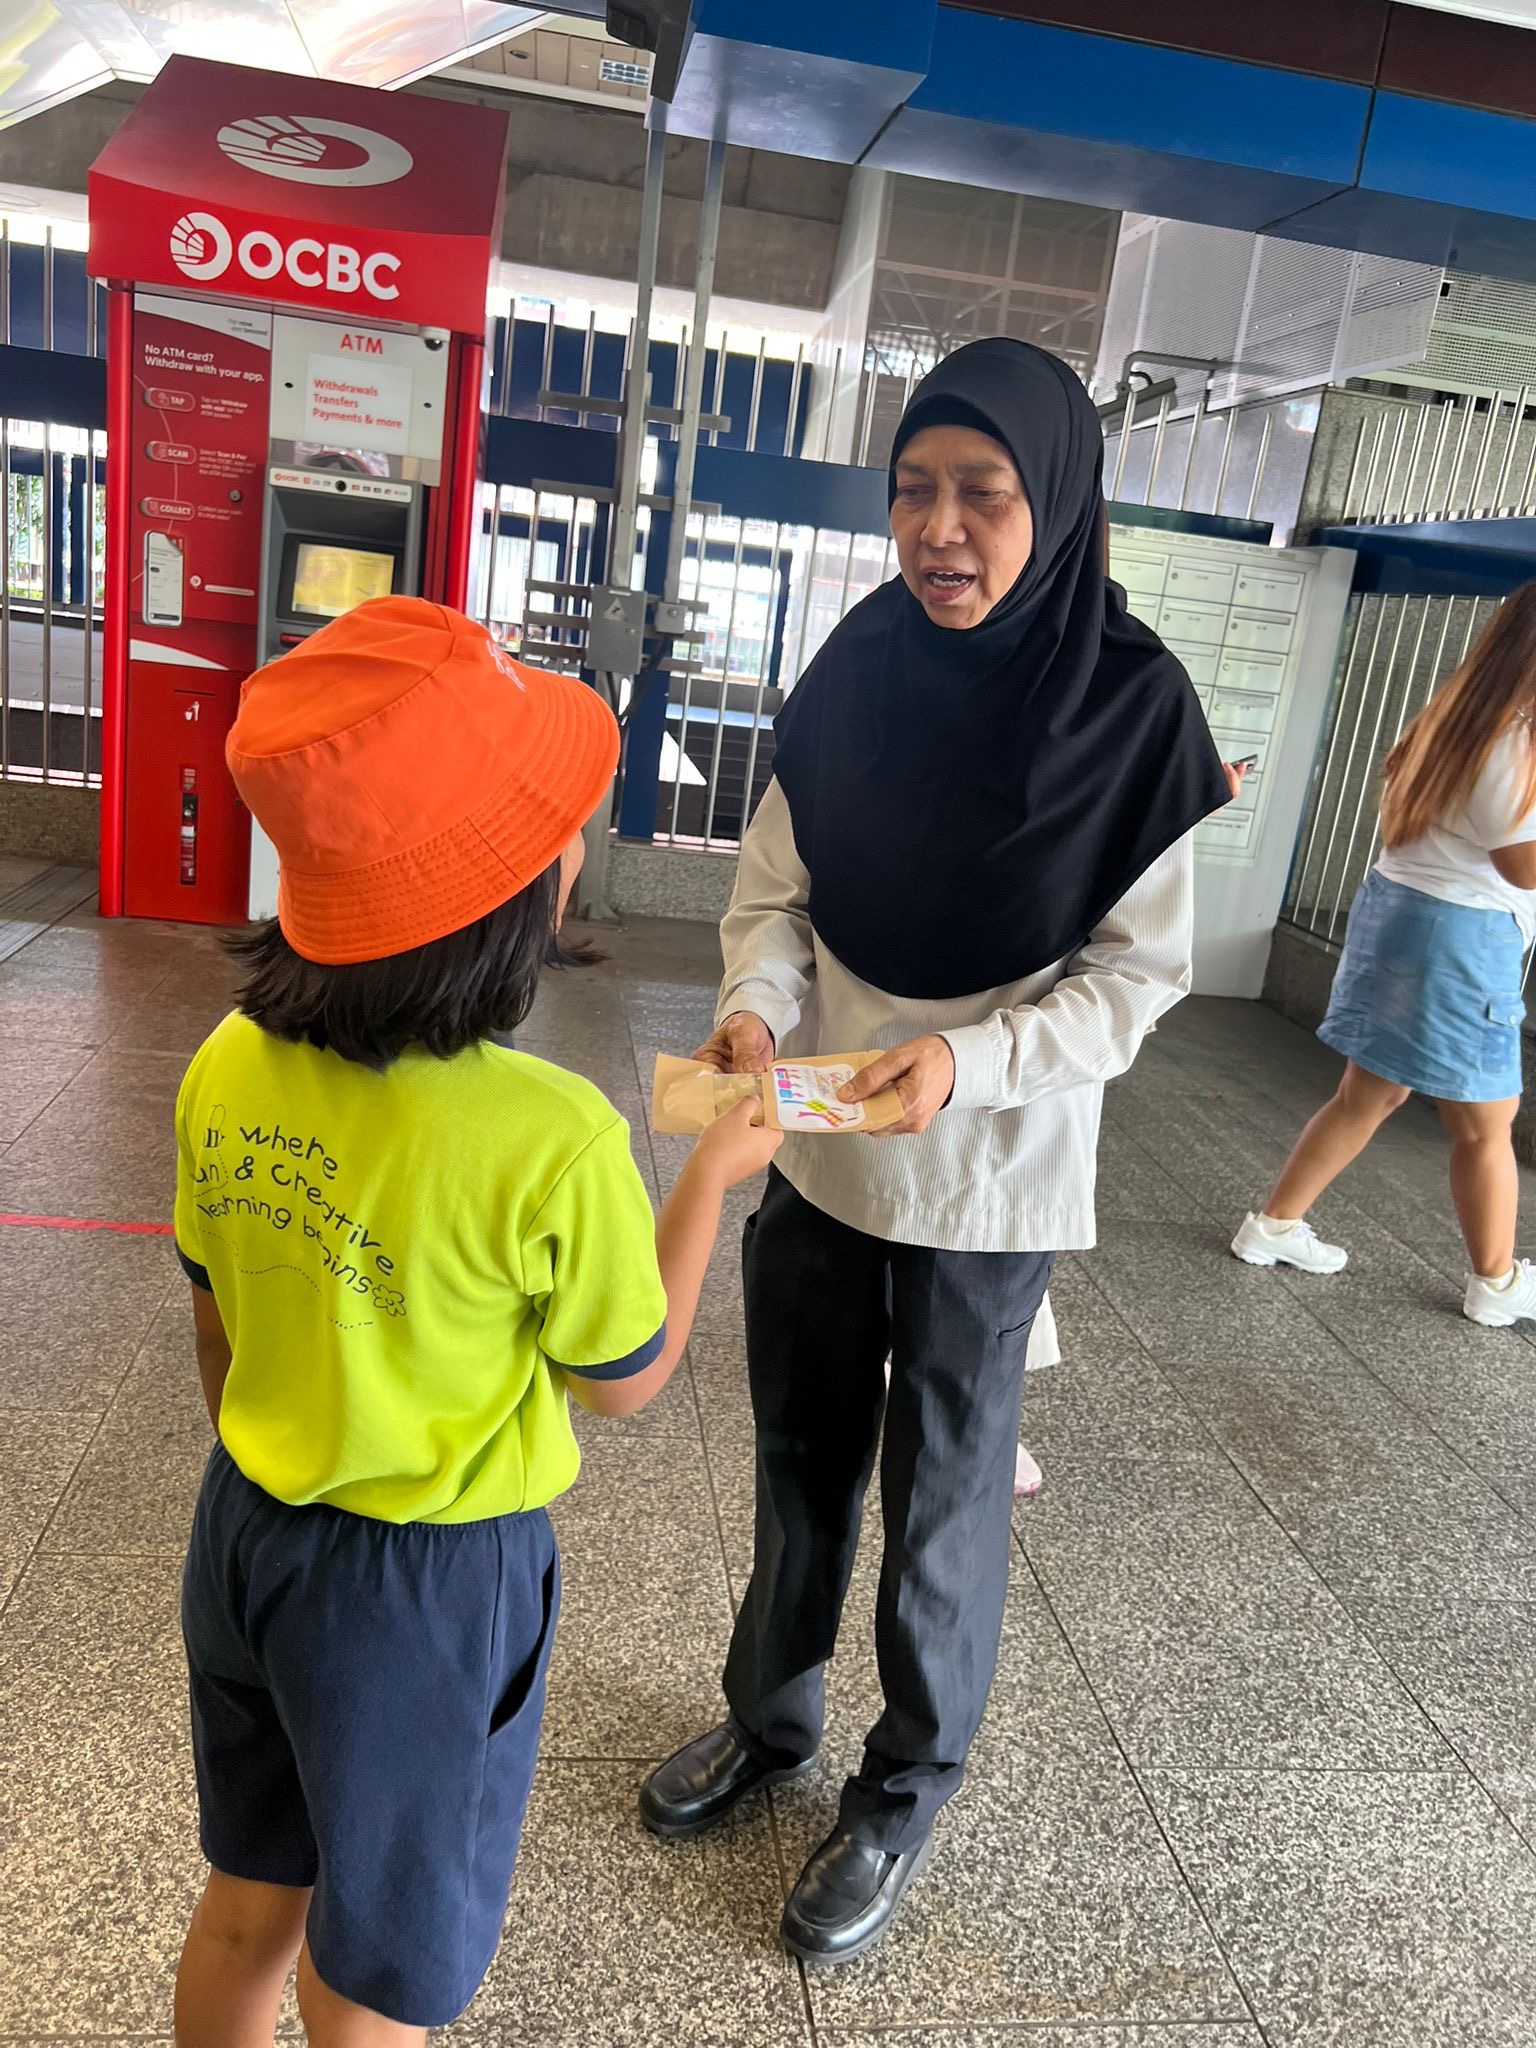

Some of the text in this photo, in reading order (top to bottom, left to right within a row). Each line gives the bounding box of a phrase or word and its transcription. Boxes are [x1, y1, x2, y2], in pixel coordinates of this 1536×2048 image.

[238, 230, 401, 300] OCBC
[144, 344, 214, 362] No ATM card?
[340, 333, 384, 355] ATM
[144, 356, 265, 383] Withdraw with your app.
[313, 379, 378, 397] Withdrawals
[312, 393, 359, 408] Transfers
[312, 408, 402, 429] Payments & more
[160, 503, 191, 515] COLLECT
[239, 1125, 338, 1180] where
[234, 1155, 254, 1181] &
[196, 1195, 291, 1229] learning
